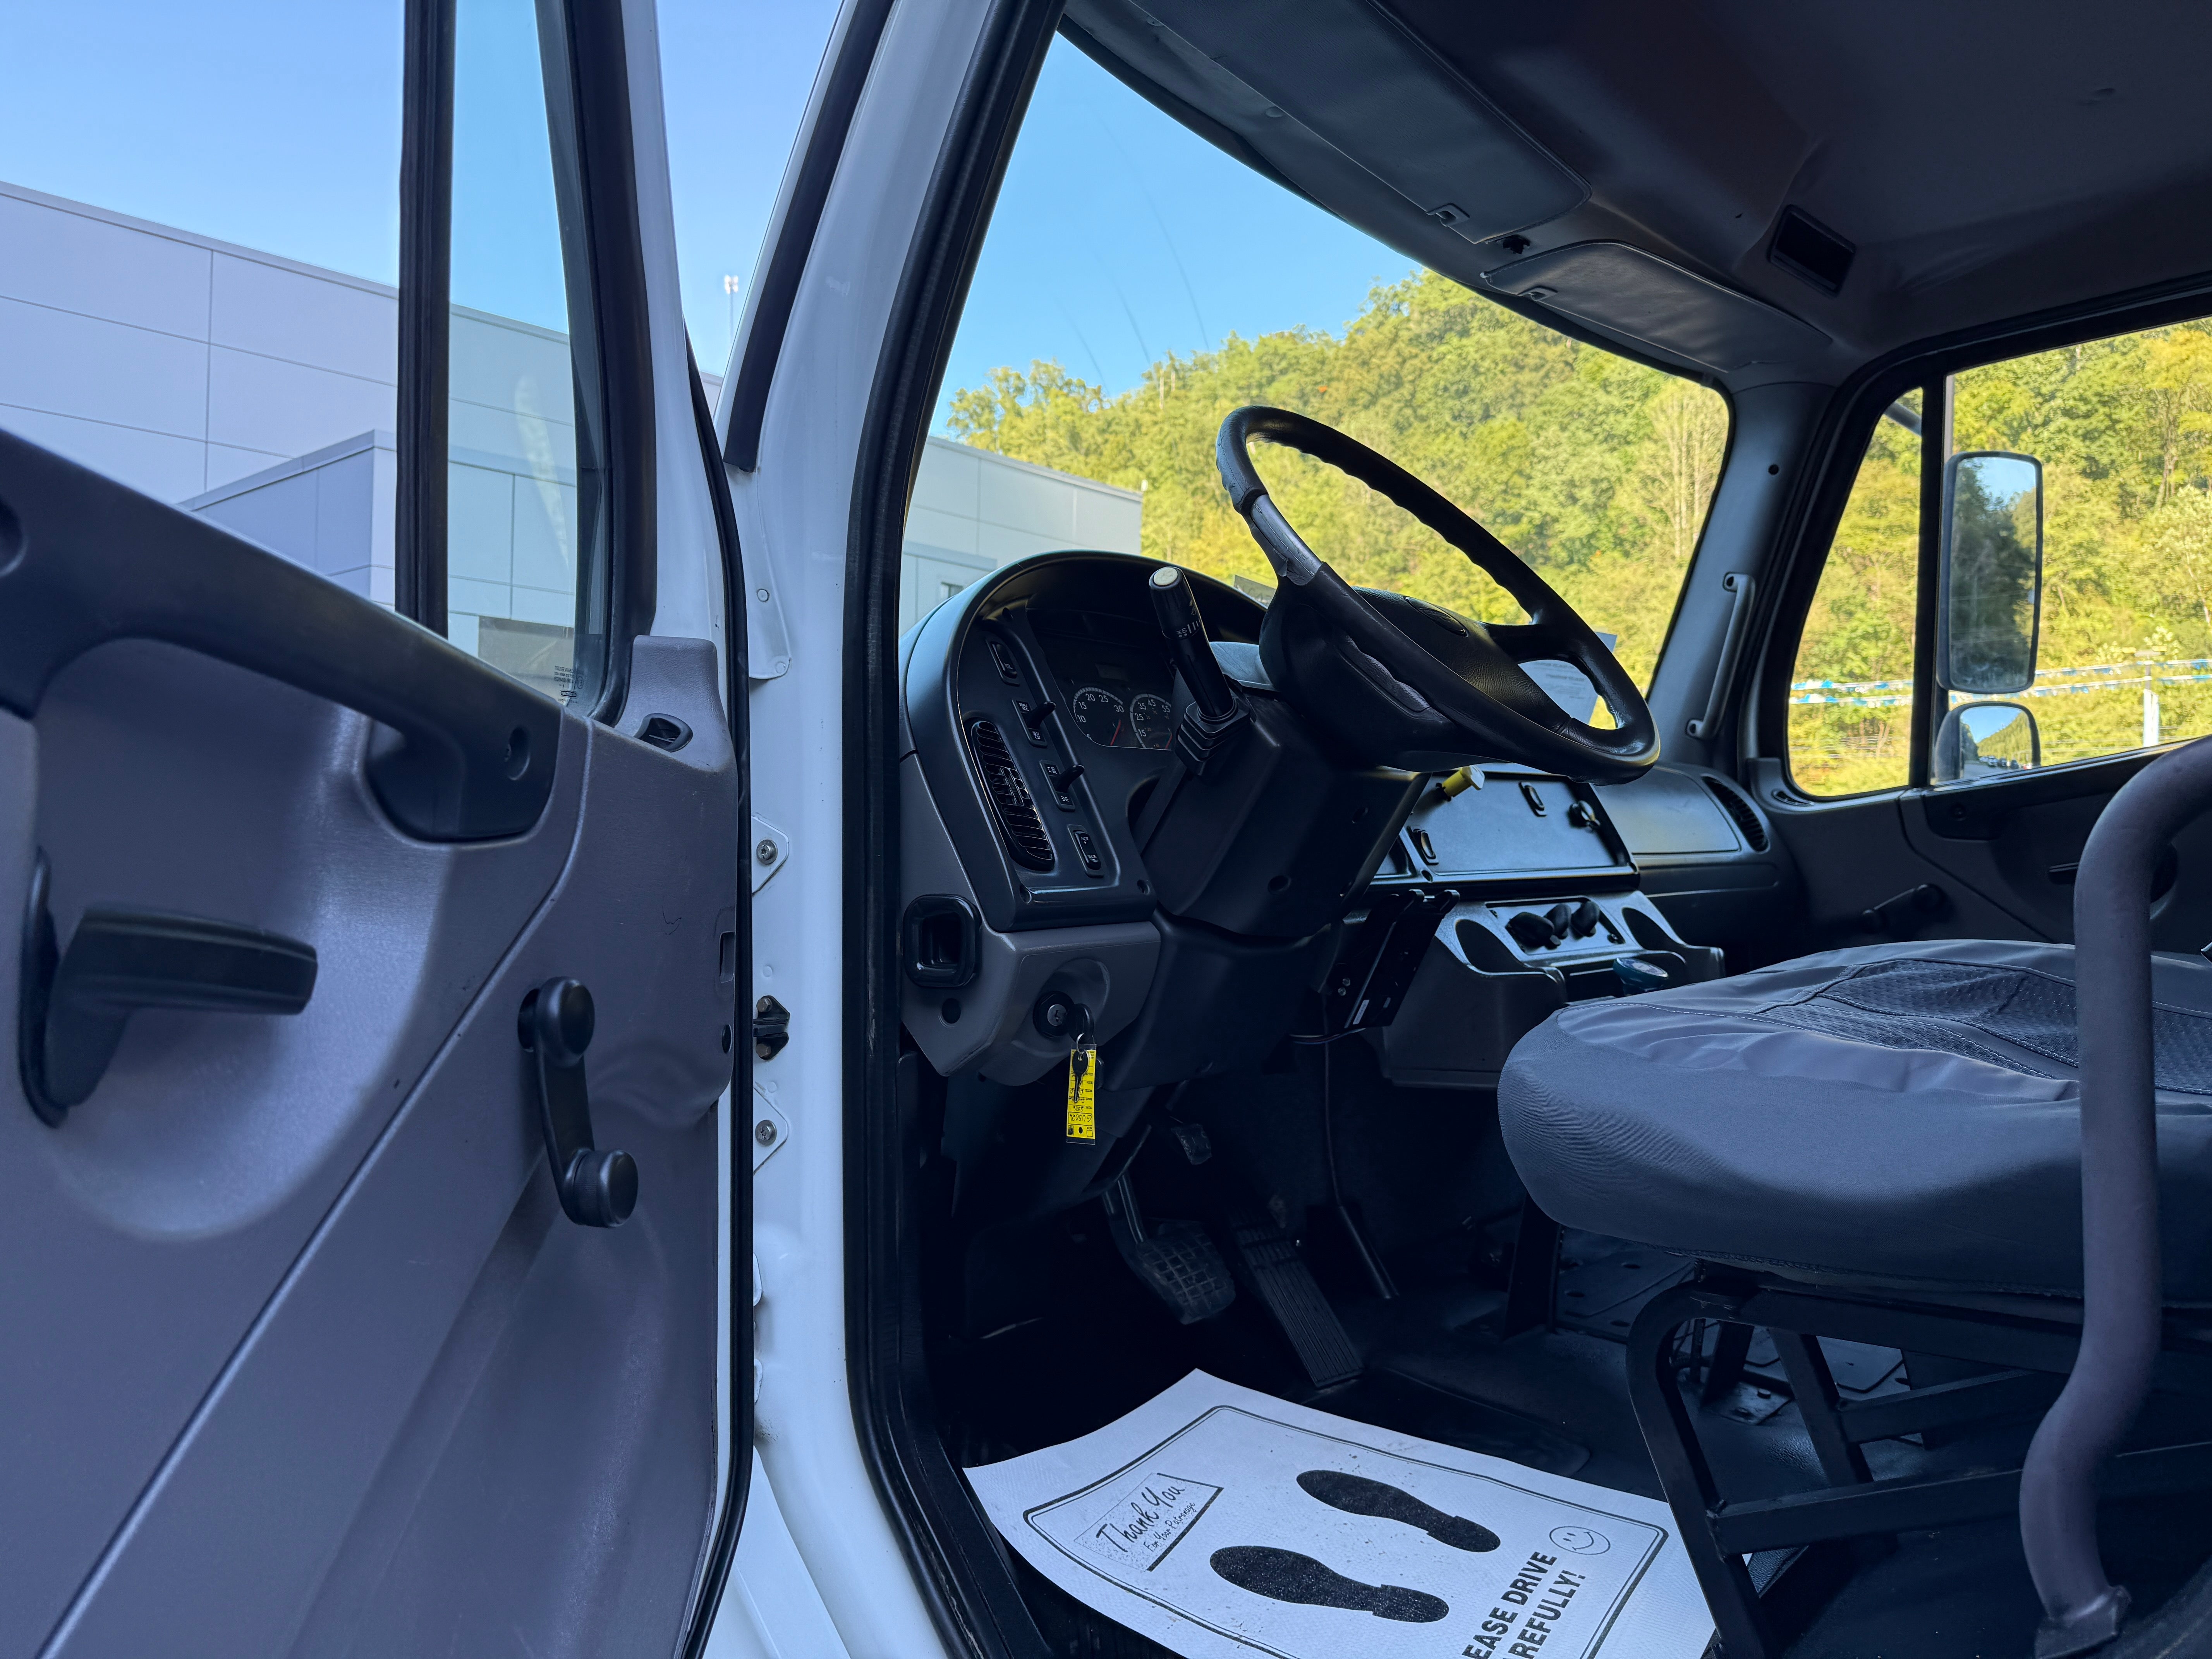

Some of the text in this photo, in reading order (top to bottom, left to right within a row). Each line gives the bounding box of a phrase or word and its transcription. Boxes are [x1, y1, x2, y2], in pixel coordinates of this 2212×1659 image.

[1085, 693, 1095, 701] 20
[1099, 694, 1109, 702] 25
[1161, 705, 1170, 713] 55
[1134, 713, 1144, 721] 25
[1138, 729, 1146, 737] 15
[1096, 1486, 1185, 1552] Thank You
[1143, 1502, 1195, 1552] For Your Patronage
[1462, 1551, 1557, 1659] EASE DRIVE
[1503, 1570, 1586, 1659] REFULLY!
